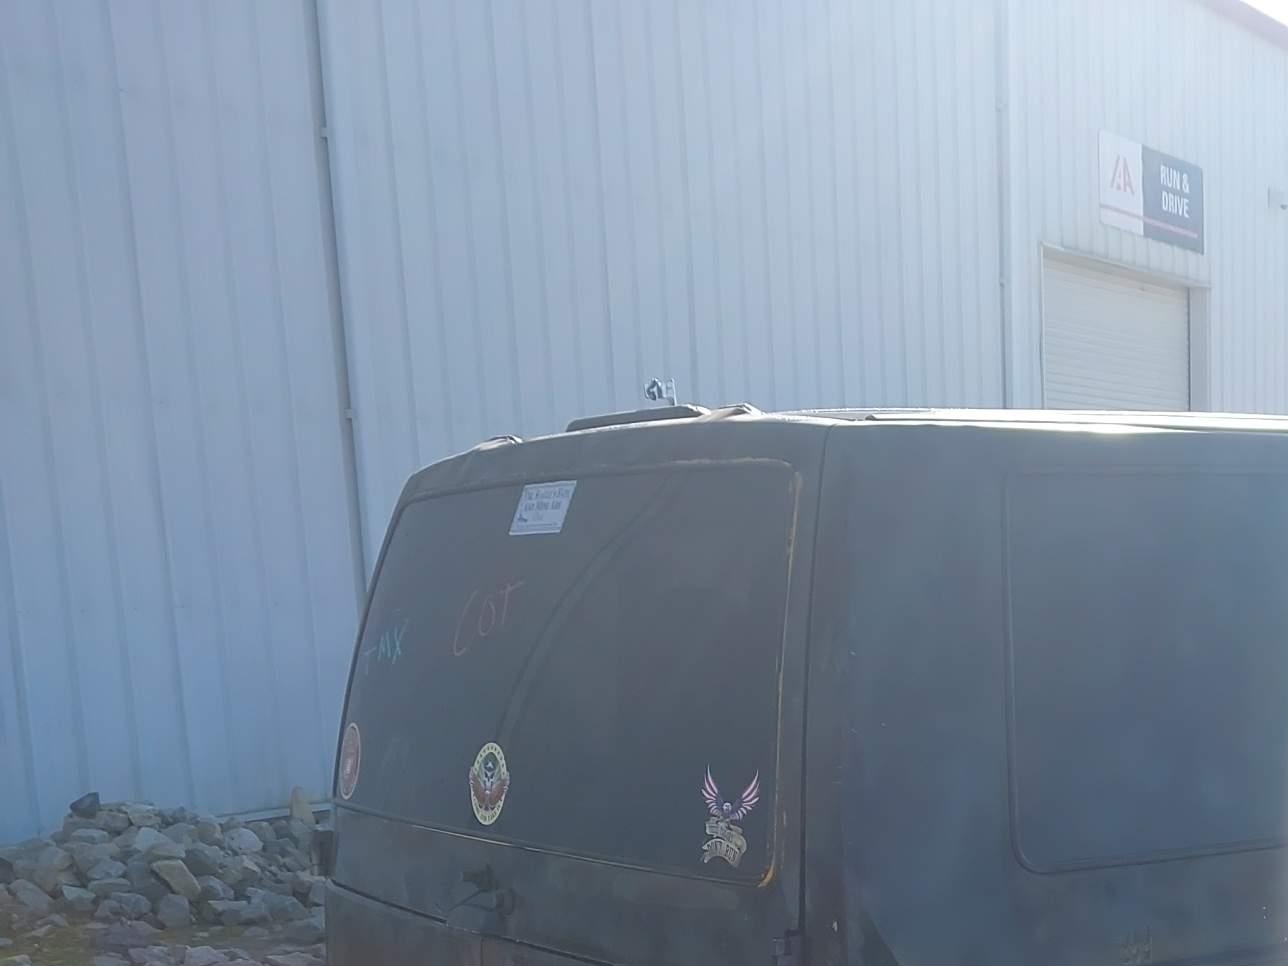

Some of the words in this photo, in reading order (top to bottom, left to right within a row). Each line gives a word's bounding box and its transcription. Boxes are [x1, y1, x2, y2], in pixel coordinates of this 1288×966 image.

[1160, 164, 1181, 190] RUN
[1182, 172, 1191, 194] &
[1161, 190, 1190, 219] DRIVE
